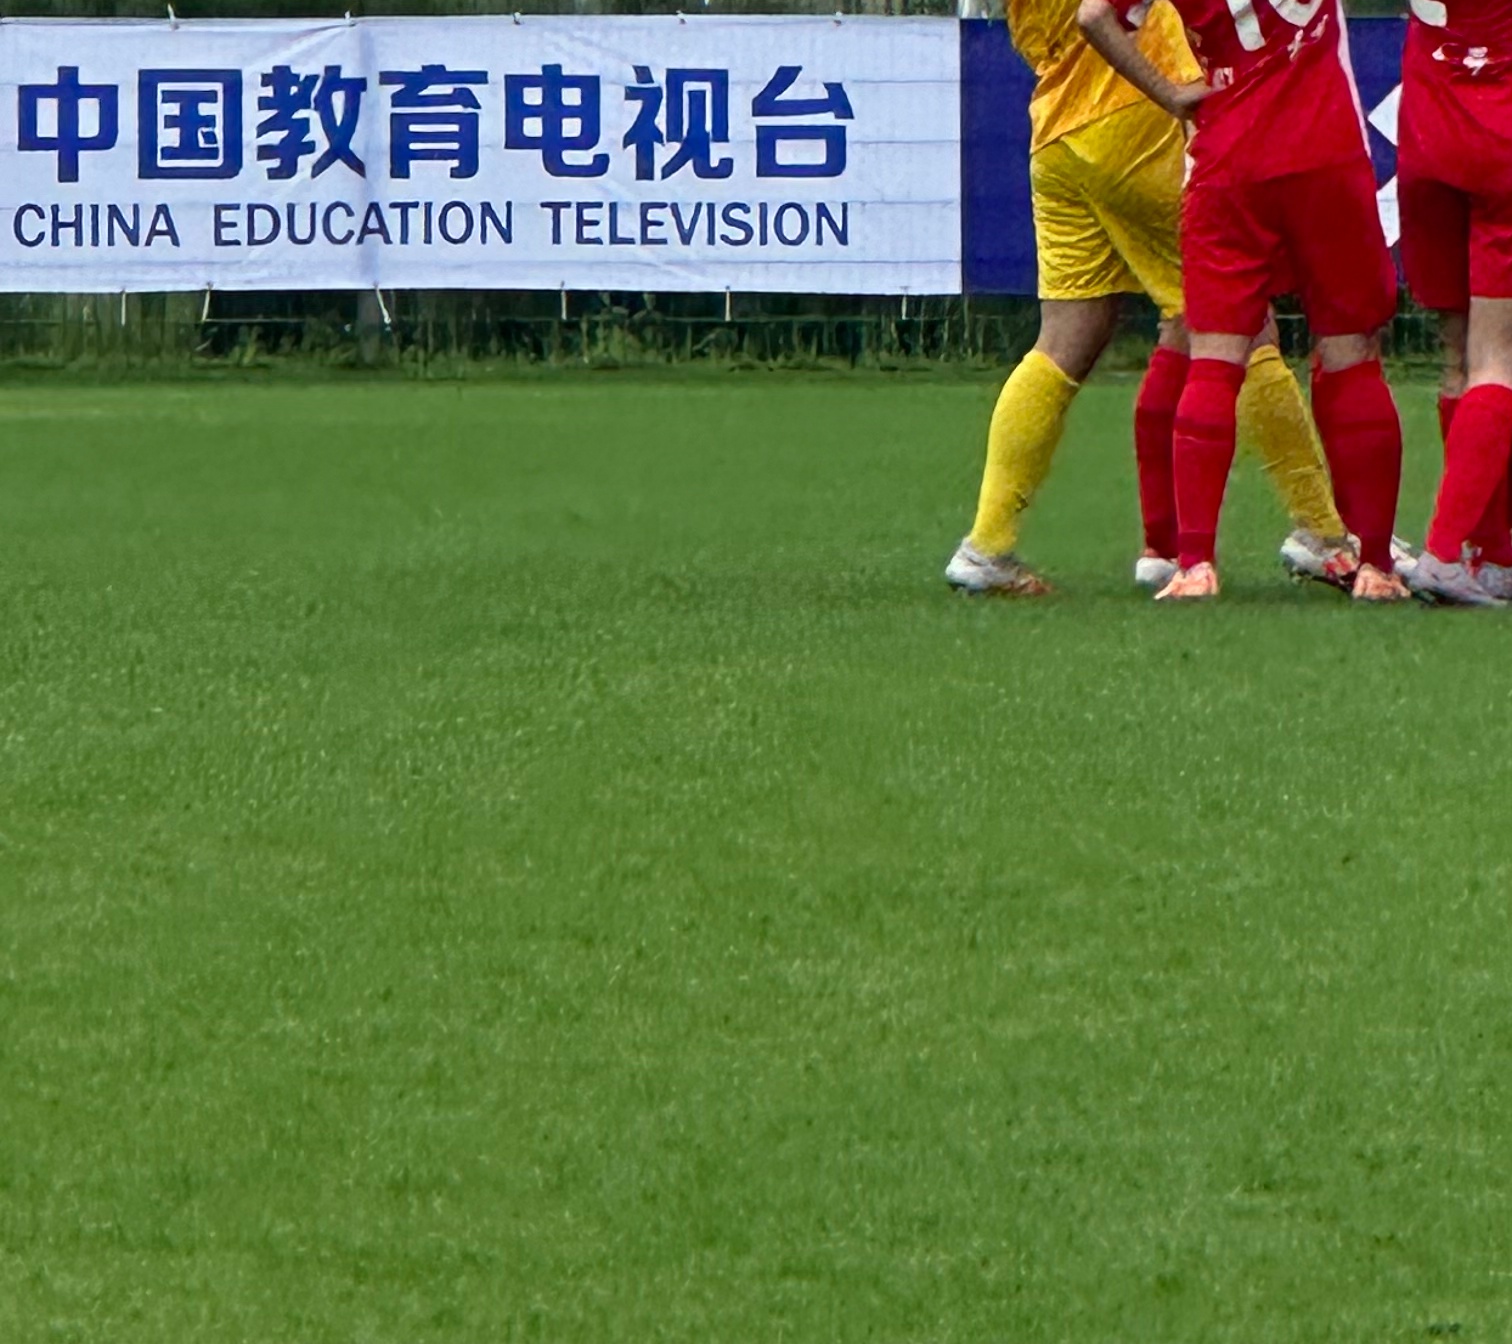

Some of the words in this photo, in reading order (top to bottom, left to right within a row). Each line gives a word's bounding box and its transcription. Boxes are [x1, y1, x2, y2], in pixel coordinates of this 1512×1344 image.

[17, 63, 855, 183] 中国教育电视台
[13, 203, 180, 247] CHINA
[213, 201, 513, 247] EDUCATION
[540, 201, 849, 246] TELEVISION
